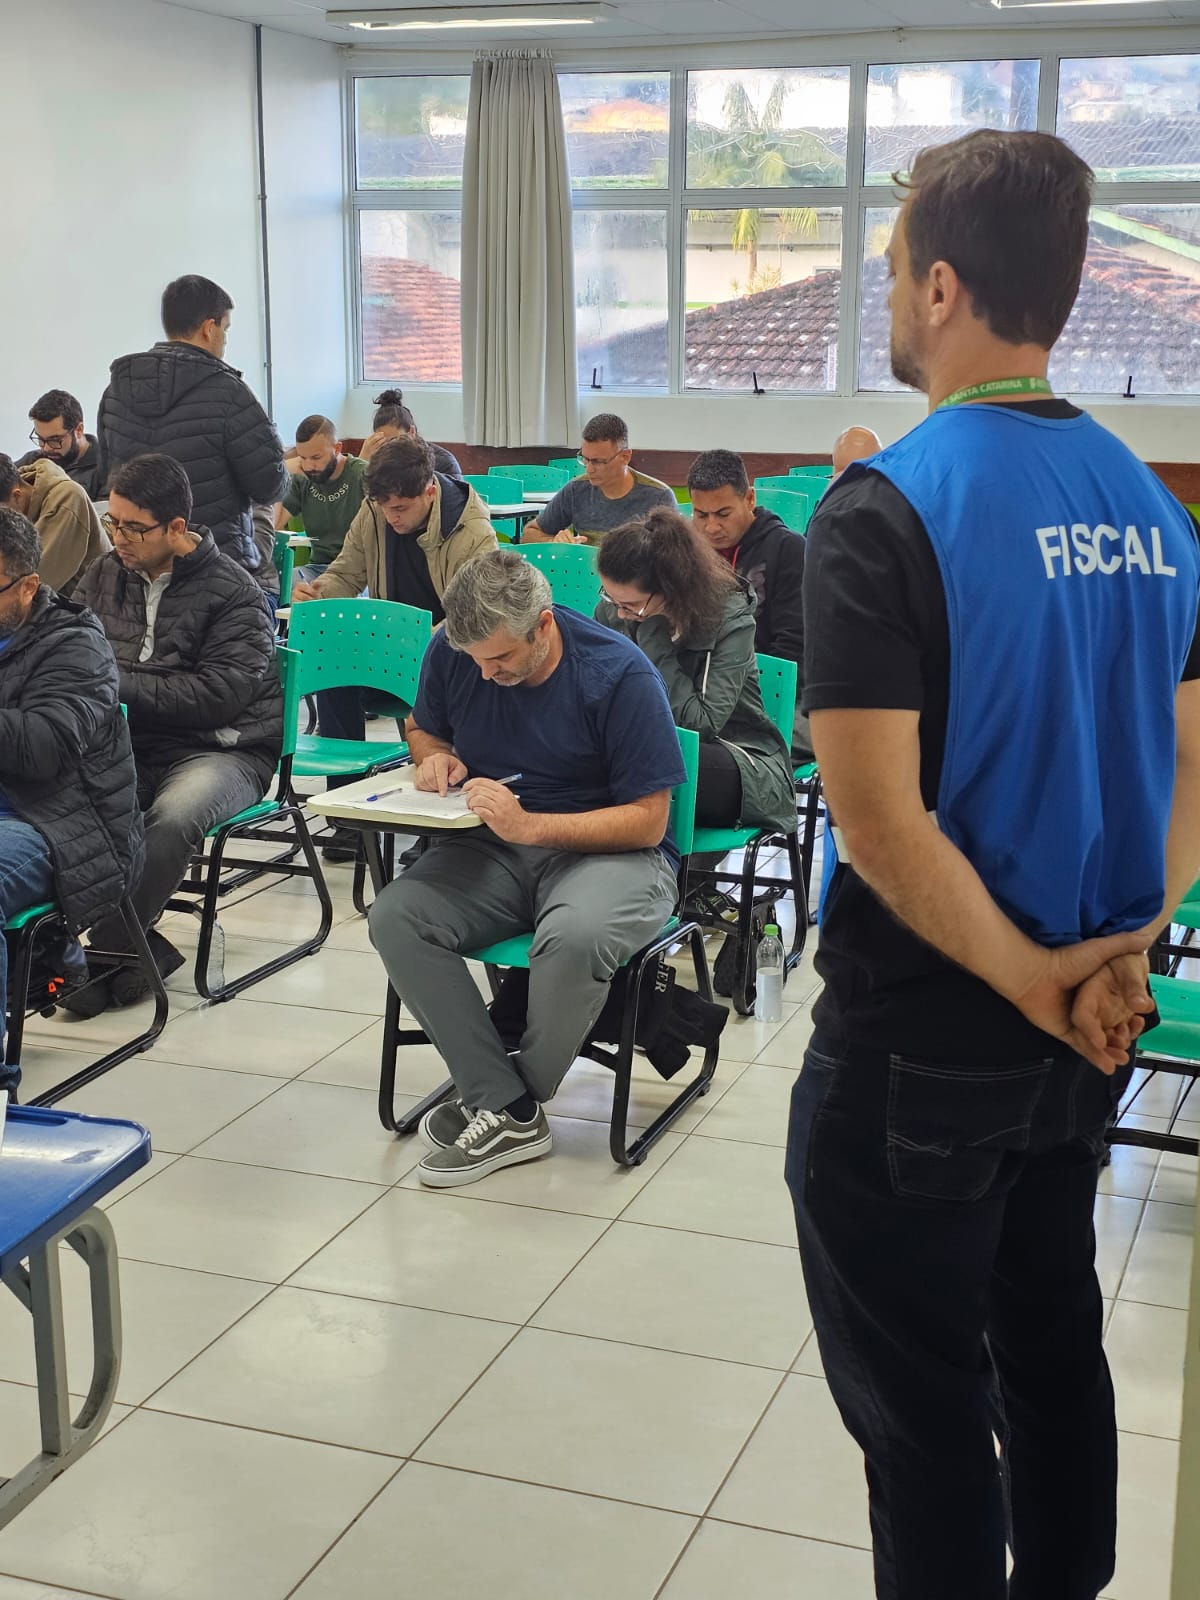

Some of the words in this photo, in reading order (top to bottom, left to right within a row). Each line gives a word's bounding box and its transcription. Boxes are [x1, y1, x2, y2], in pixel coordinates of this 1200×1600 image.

[949, 387, 979, 403] SANTA
[328, 482, 349, 502] BOSS
[1035, 523, 1177, 579] FISCAL
